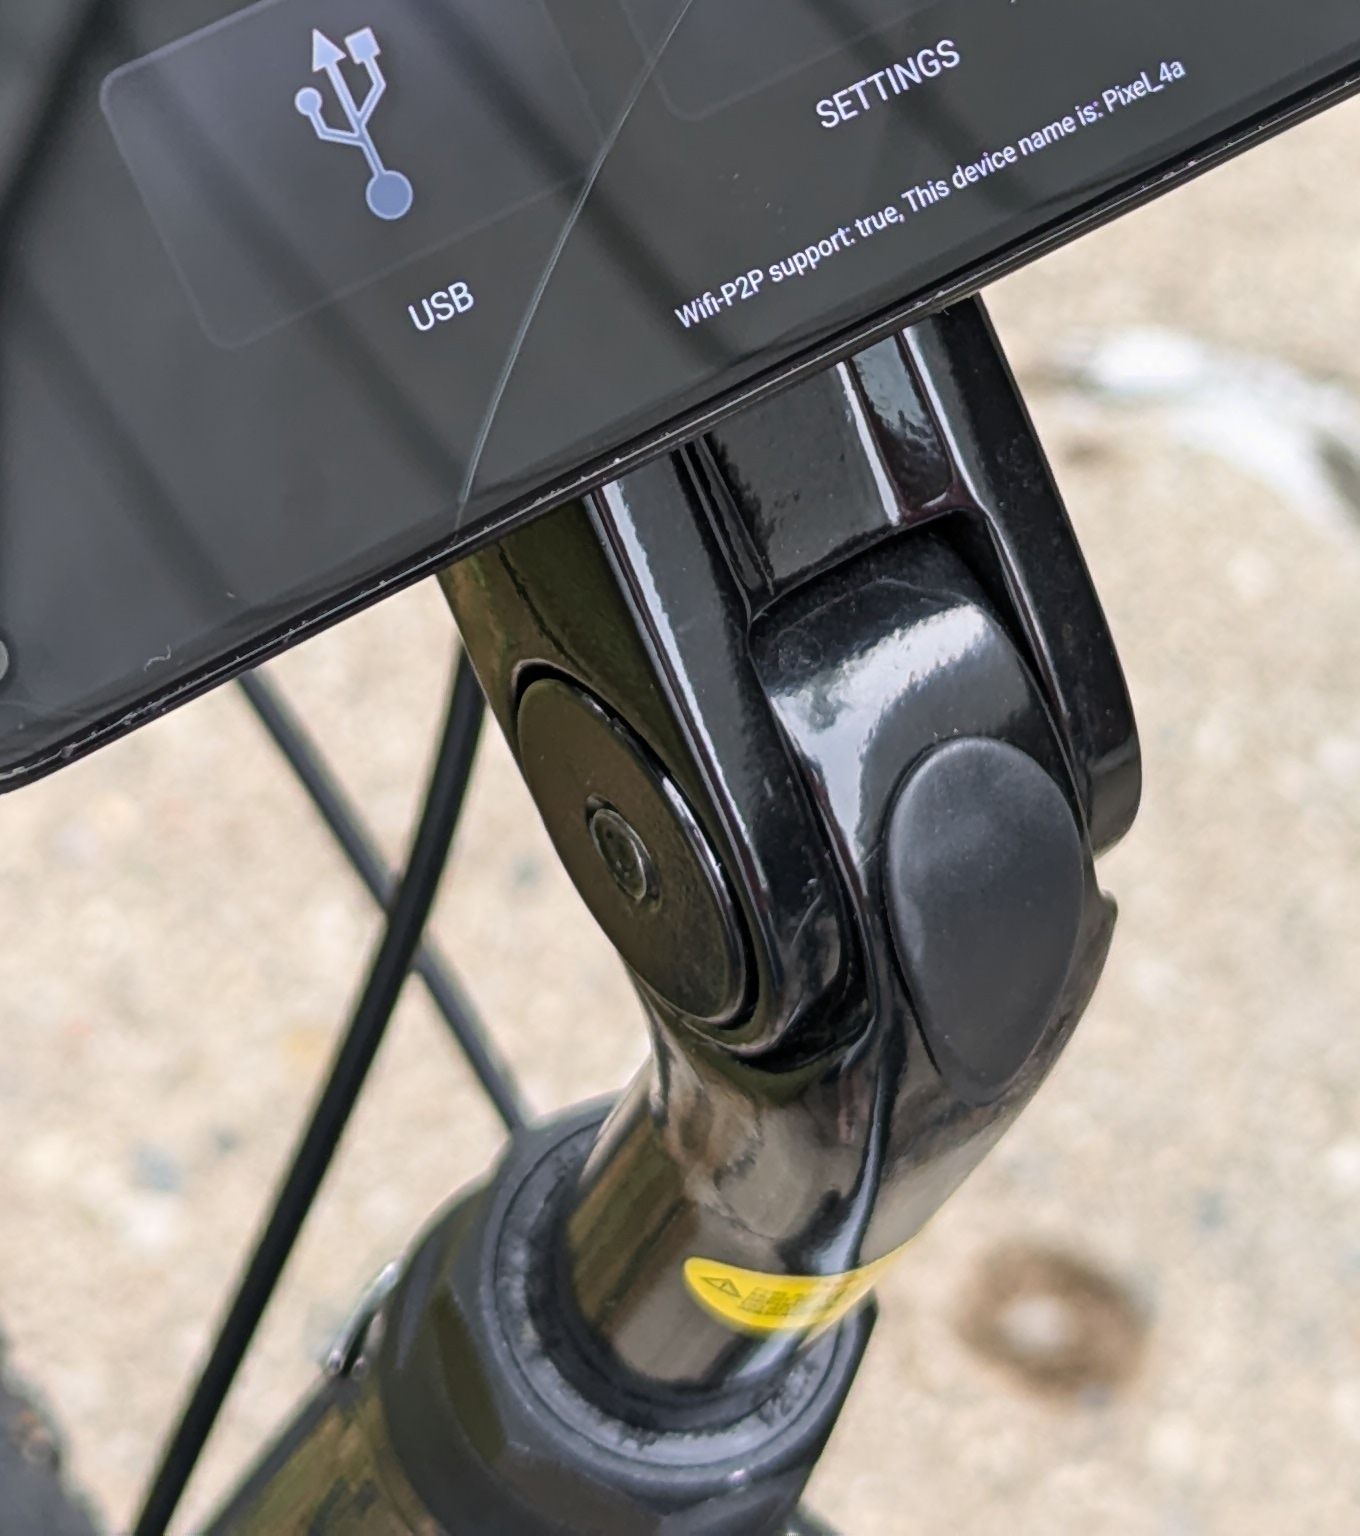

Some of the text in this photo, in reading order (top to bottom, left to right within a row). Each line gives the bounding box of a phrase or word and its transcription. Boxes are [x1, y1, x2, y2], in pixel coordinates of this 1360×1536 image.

[814, 39, 962, 128] SETTINGS
[674, 60, 1187, 328] Wifi-P2P support: true, This device name is: Pixel_4a
[406, 281, 475, 331] USB
